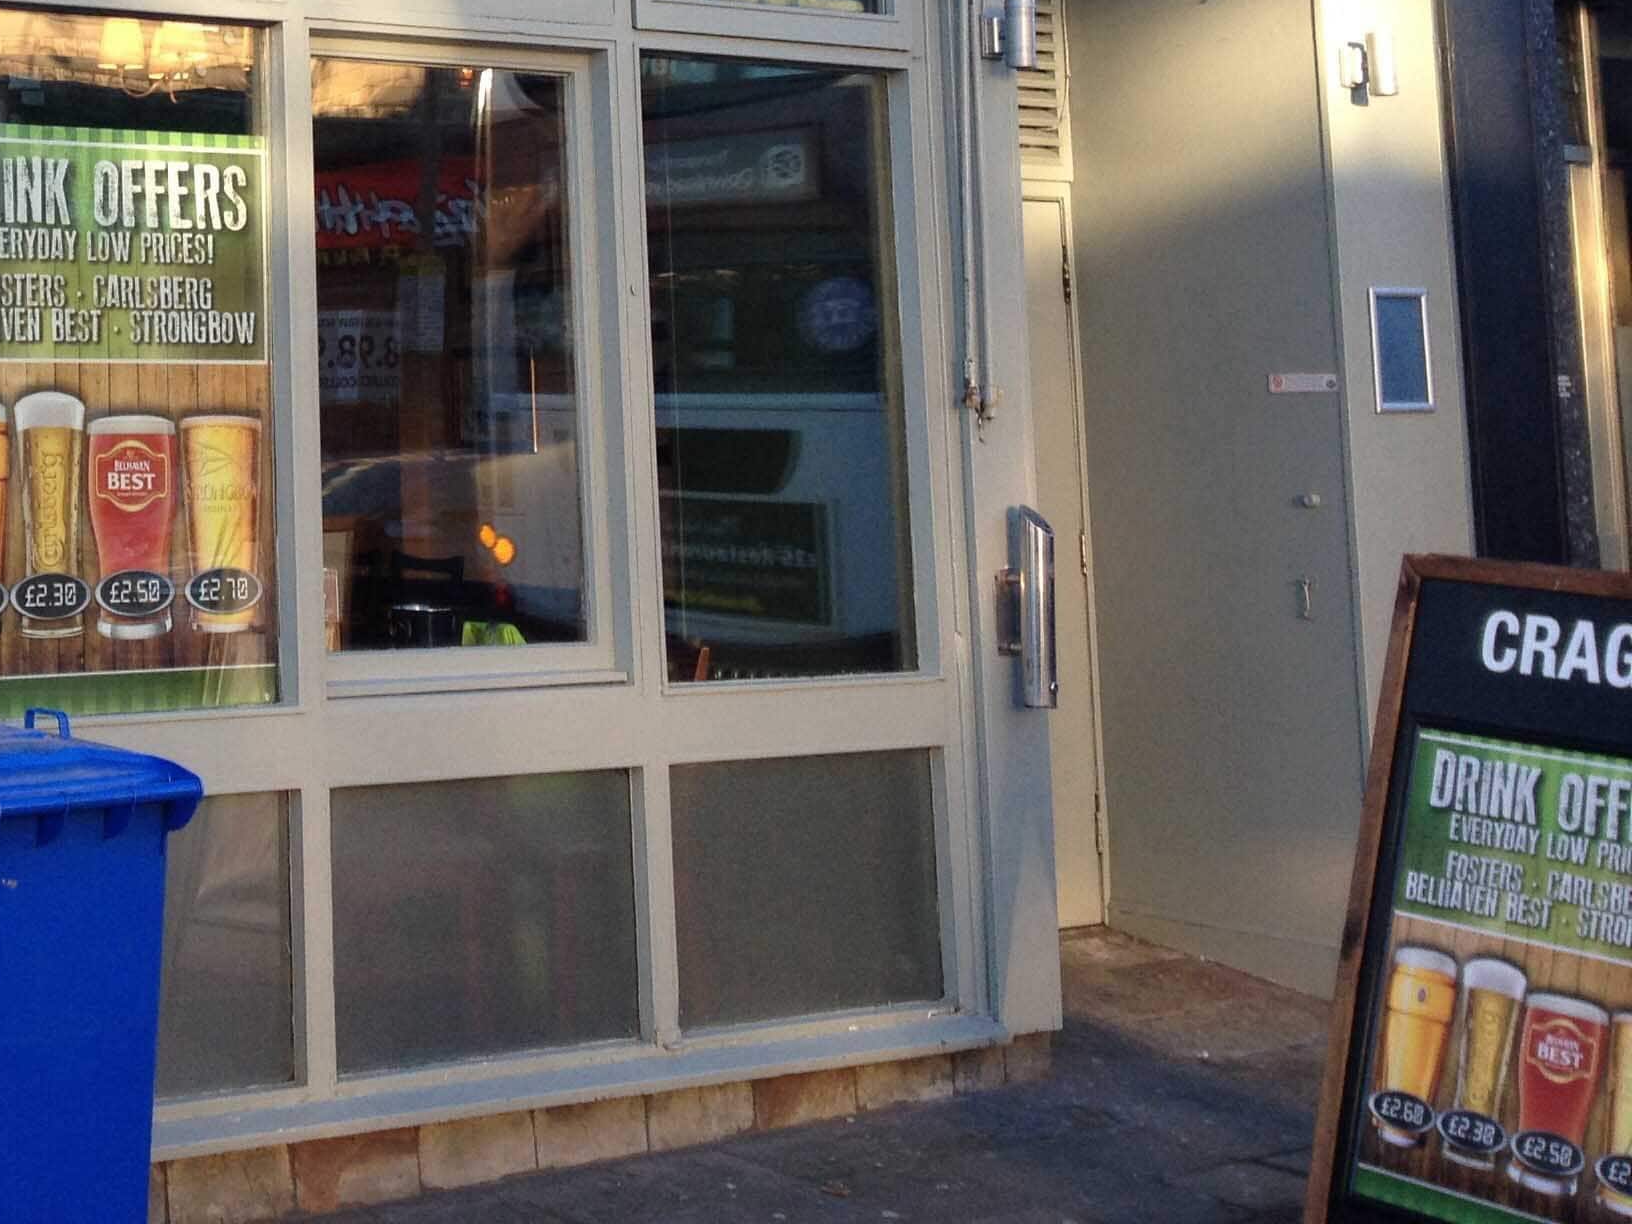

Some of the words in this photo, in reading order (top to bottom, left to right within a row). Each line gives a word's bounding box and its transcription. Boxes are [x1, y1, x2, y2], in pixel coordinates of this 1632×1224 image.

[94, 160, 247, 231] OFFERS
[87, 231, 131, 264] LOW
[140, 233, 214, 264] PRICES!
[92, 276, 212, 309] CARLSBERG
[52, 309, 101, 342] BEST
[130, 311, 256, 345] STRONGBOW
[107, 473, 156, 490] BEST
[24, 584, 76, 607] £2.30
[109, 580, 160, 604] £2.50
[198, 578, 248, 600] £2.70
[1481, 610, 1632, 689] CRAG
[1430, 748, 1541, 825] DRINK
[1558, 773, 1632, 844] OFF
[1449, 812, 1540, 855] EVERYDAY
[1546, 832, 1589, 865] LOW
[1446, 850, 1523, 892] FOSTERS
[1405, 871, 1499, 918] BELHAVEN
[1505, 892, 1552, 929] BEST
[1576, 908, 1632, 948] STRO
